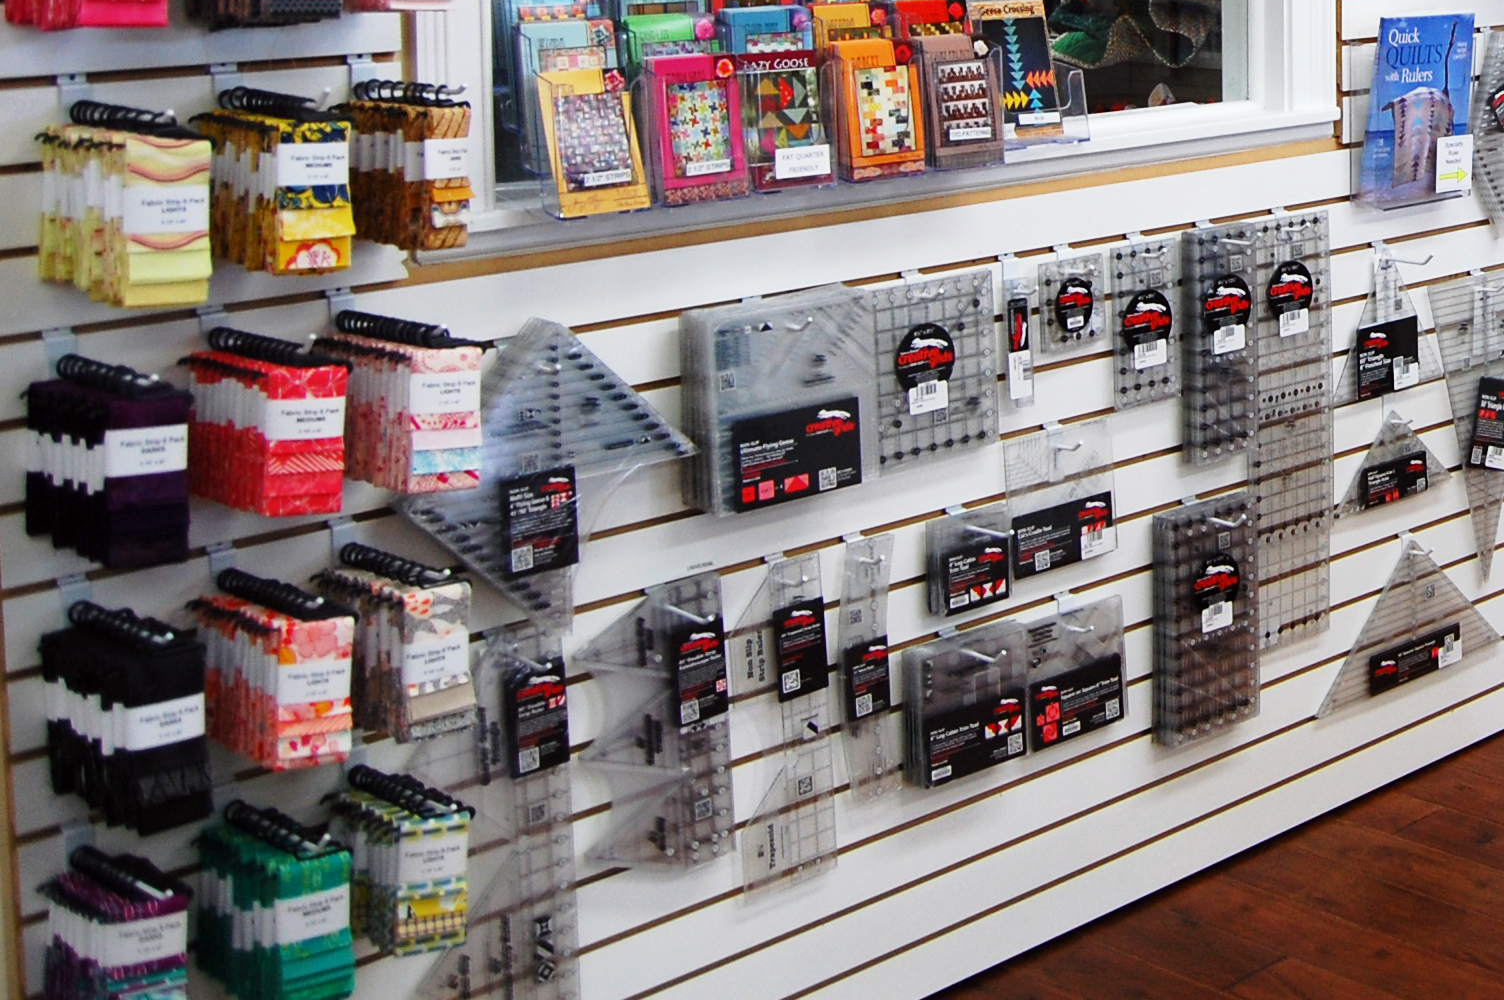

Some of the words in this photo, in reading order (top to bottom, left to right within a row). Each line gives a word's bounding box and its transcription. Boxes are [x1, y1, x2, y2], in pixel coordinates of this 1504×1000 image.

[1003, 4, 1036, 18] Crossing
[1388, 26, 1421, 46] Quick
[773, 56, 809, 70] GOOSE
[1385, 42, 1443, 70] QUILTS
[1384, 70, 1400, 82] with
[1401, 66, 1434, 84] Rulers
[782, 153, 796, 162] FAT
[798, 150, 825, 161] QUARTER
[707, 161, 730, 171] STRIPS
[788, 163, 820, 174] FRIENDLY
[606, 171, 631, 182] STRIPS
